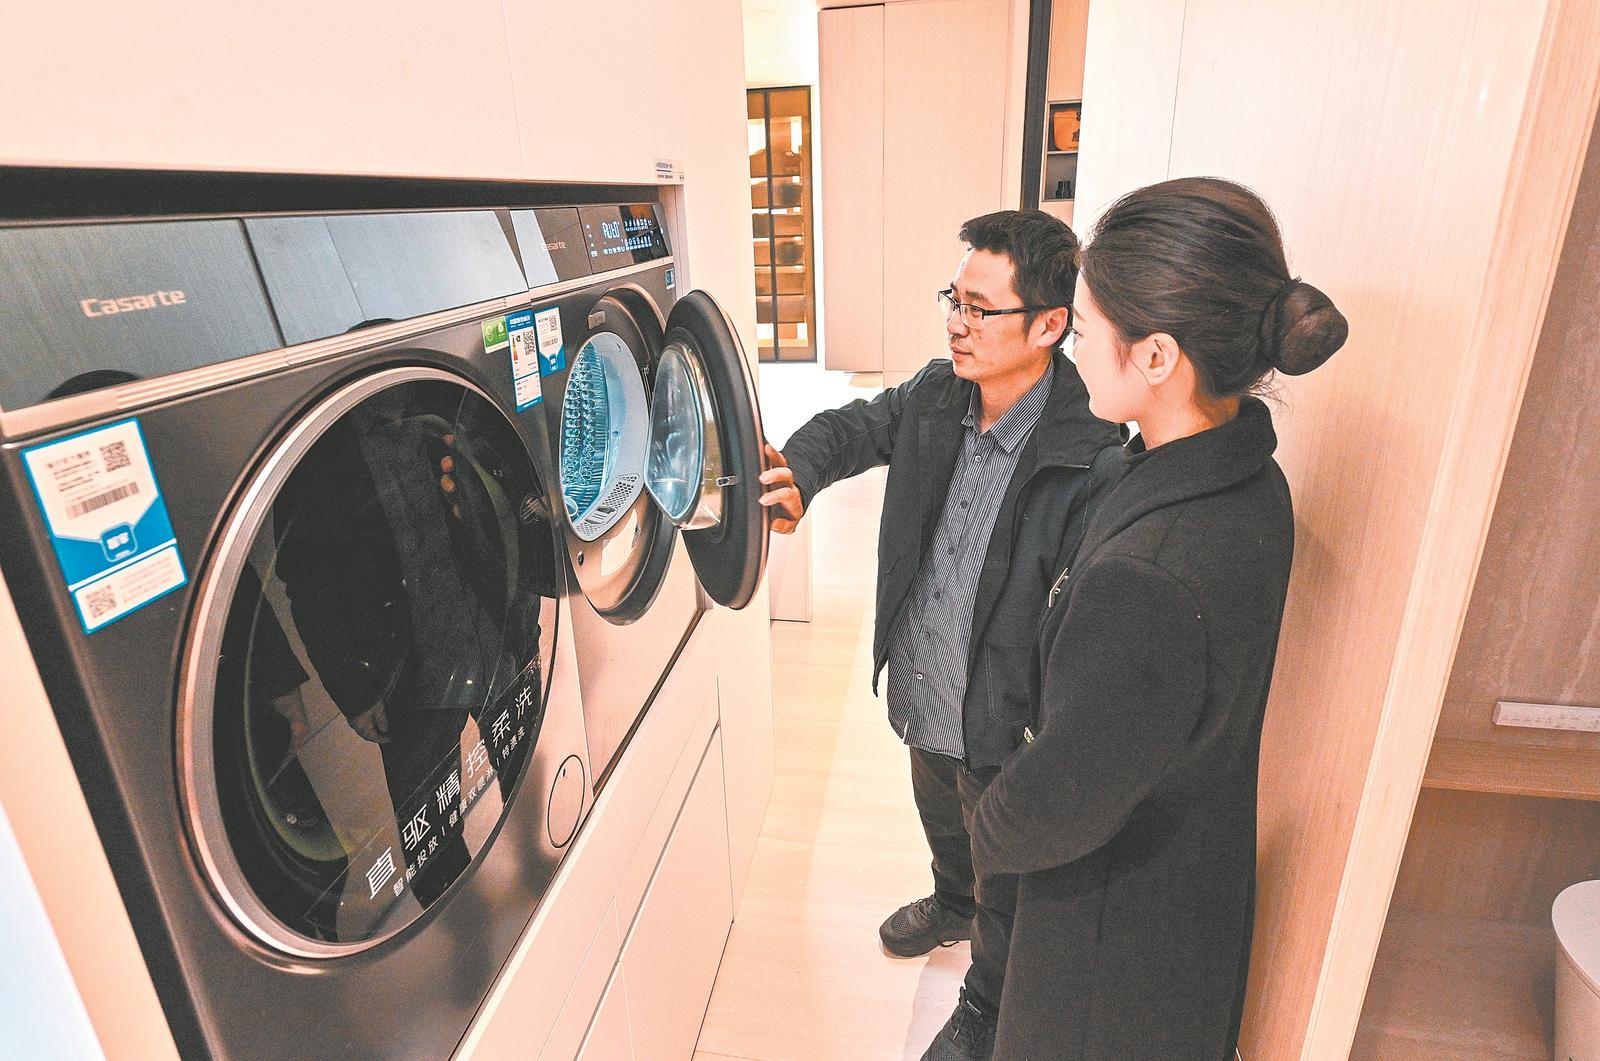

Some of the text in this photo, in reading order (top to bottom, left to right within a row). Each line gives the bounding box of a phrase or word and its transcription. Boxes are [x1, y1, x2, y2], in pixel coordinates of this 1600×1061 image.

[81, 290, 186, 317] Casarte
[366, 685, 532, 899] 直驱精控柔洗
[393, 835, 438, 897] 智能投放
